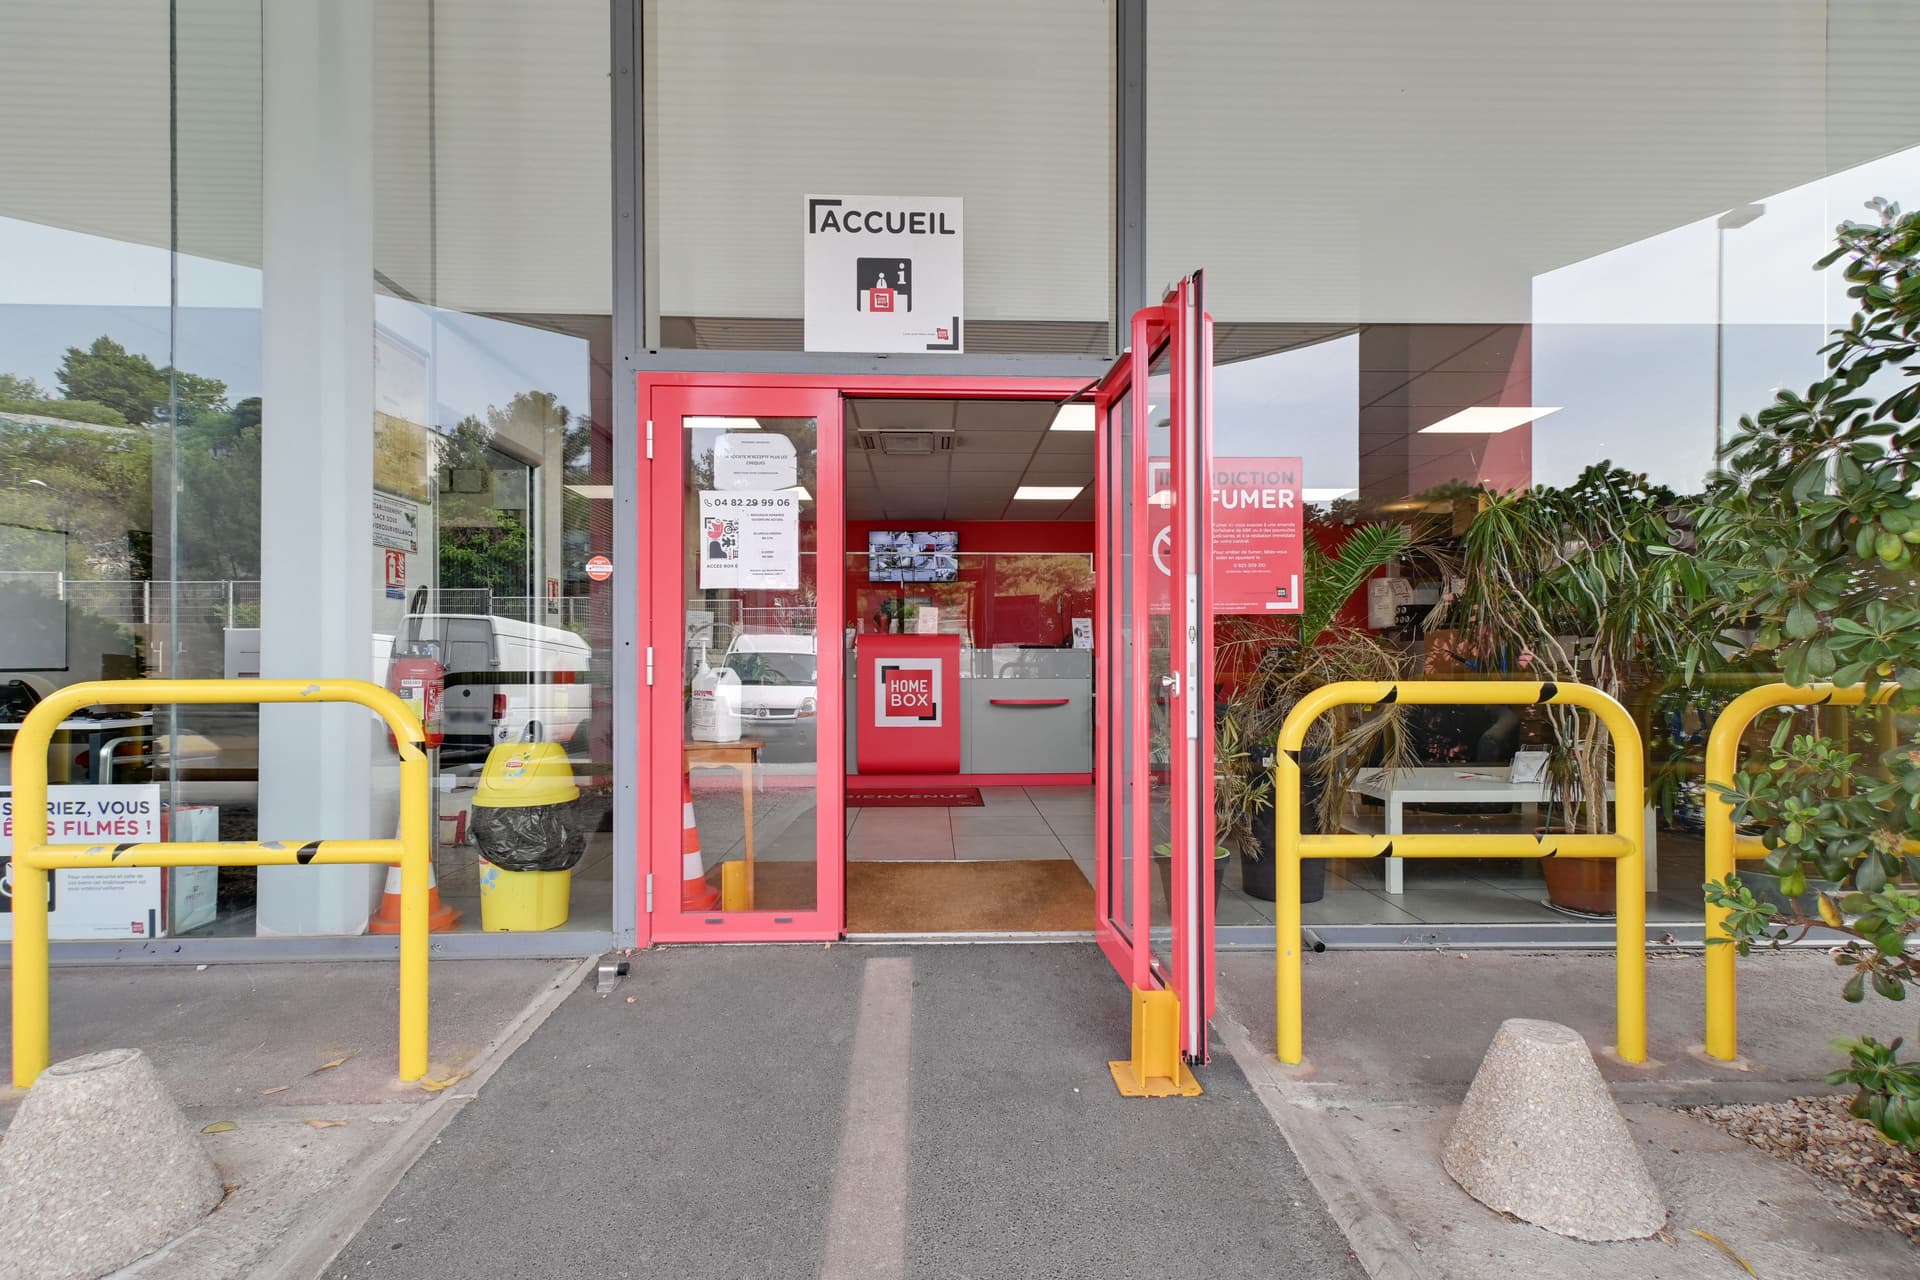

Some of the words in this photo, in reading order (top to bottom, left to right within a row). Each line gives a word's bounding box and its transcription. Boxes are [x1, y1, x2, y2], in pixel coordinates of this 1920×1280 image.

[820, 210, 956, 235] ACCUEIL
[714, 498, 728, 507] 04
[731, 498, 743, 507] 82
[761, 498, 774, 507] 99
[777, 498, 790, 507] 06
[891, 679, 928, 692] HOME
[891, 694, 928, 707] BOX
[2, 801, 92, 818] SRIEZ,
[98, 801, 150, 815] VOUS
[63, 816, 139, 836] FILMÉS
